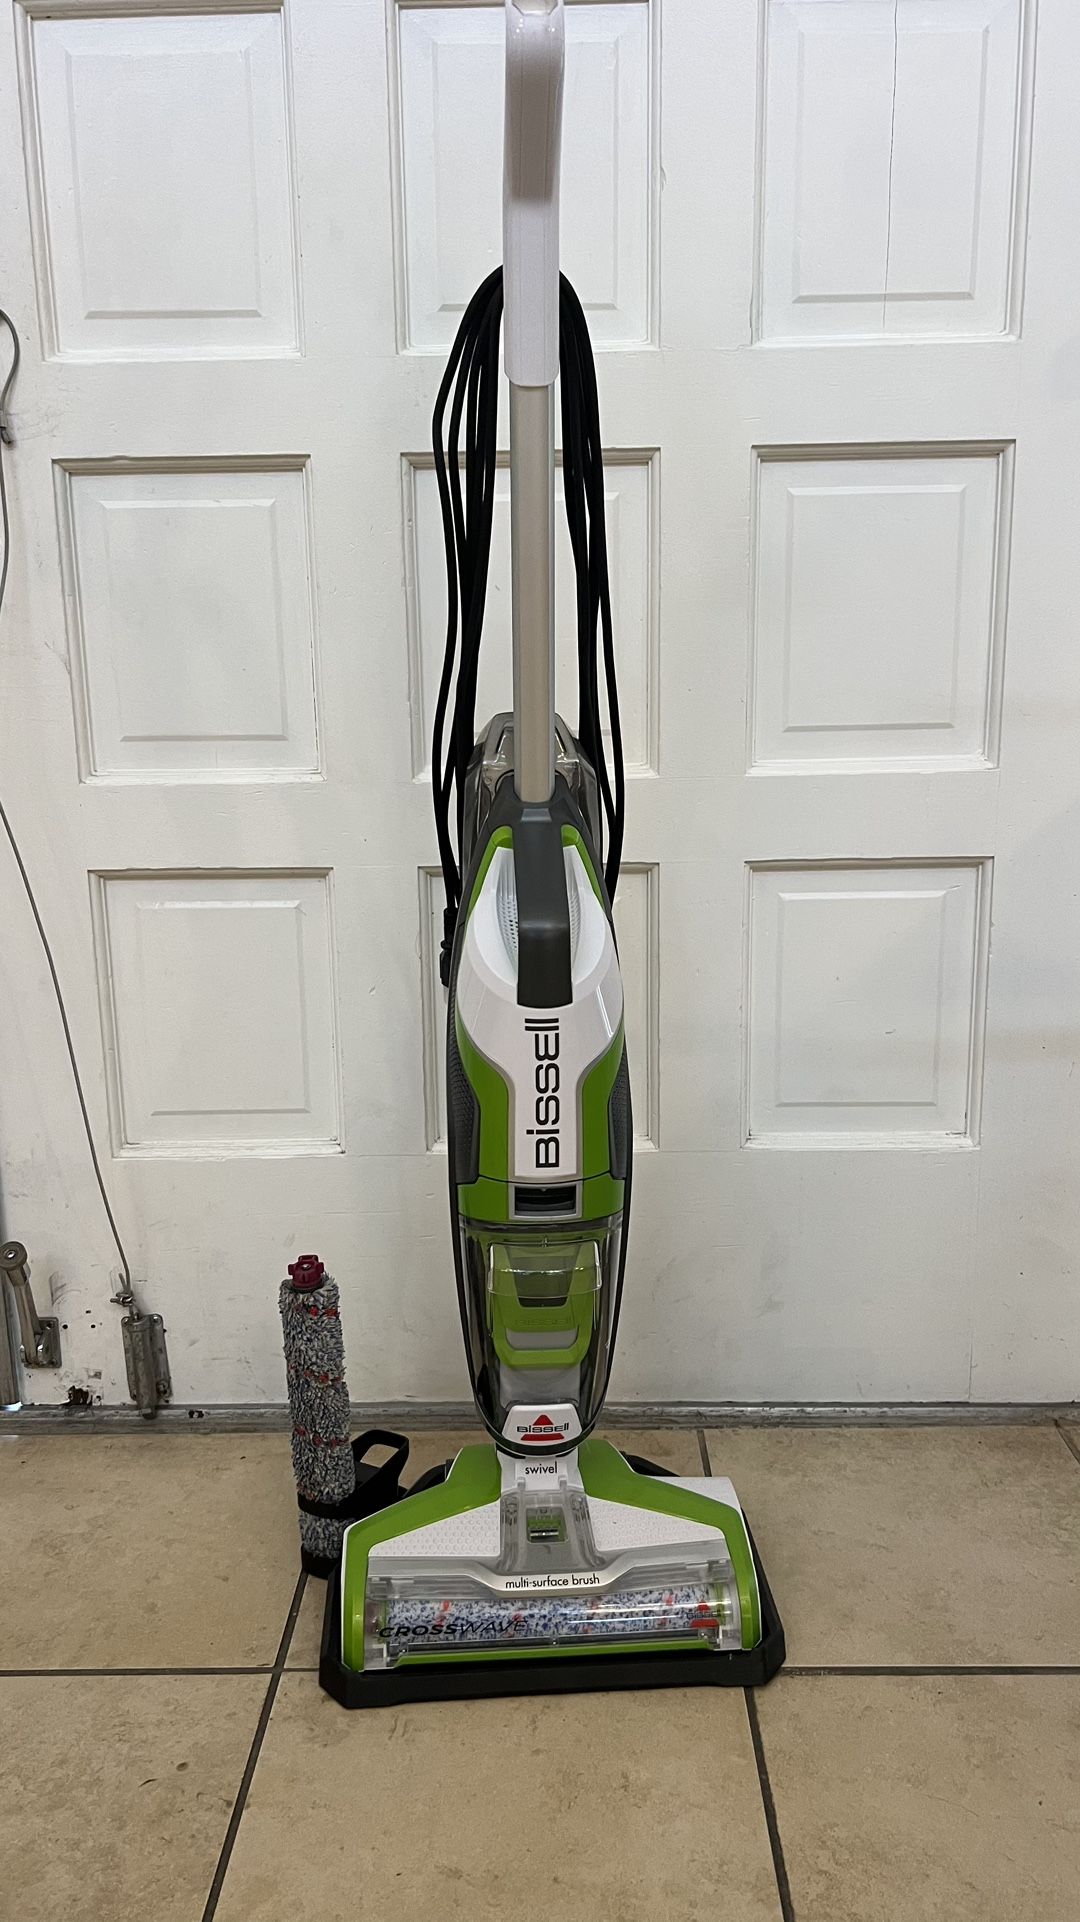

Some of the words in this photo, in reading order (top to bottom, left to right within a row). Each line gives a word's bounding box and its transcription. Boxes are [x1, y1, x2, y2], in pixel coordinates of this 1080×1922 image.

[525, 1460, 558, 1475] swivel
[505, 1575, 569, 1589] multi-surface
[571, 1572, 600, 1586] brush
[379, 1619, 529, 1638] CROSSWAVE
